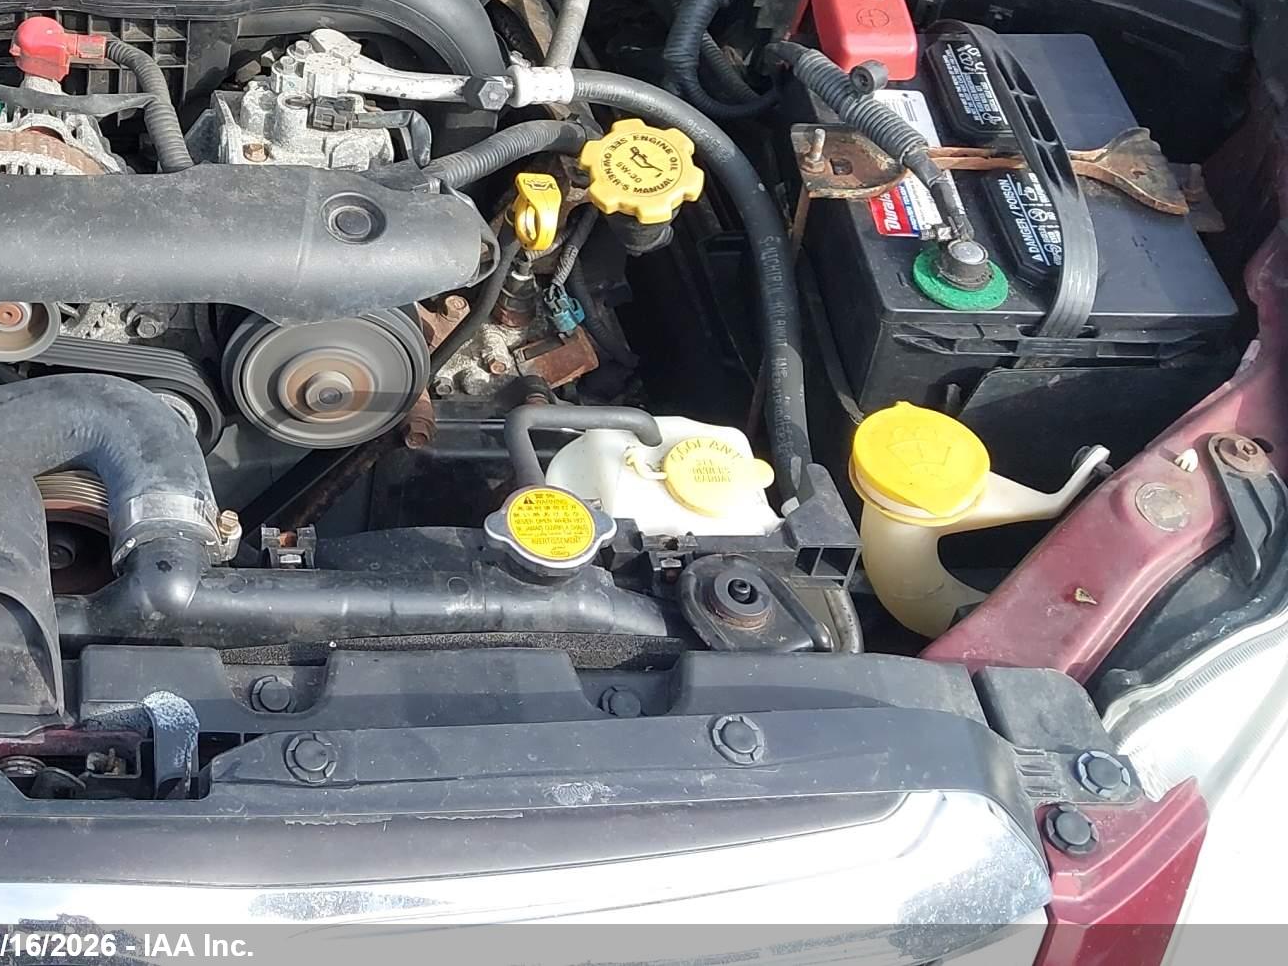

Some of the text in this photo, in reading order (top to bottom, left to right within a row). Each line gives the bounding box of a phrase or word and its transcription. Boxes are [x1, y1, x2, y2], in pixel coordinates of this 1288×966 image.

[610, 137, 629, 152] SEE
[633, 177, 674, 194] MANUAL
[632, 135, 679, 171] ENGINE OIL
[615, 161, 643, 184] 5W-30
[998, 178, 1021, 210] POISON
[1015, 218, 1040, 253] DANGER
